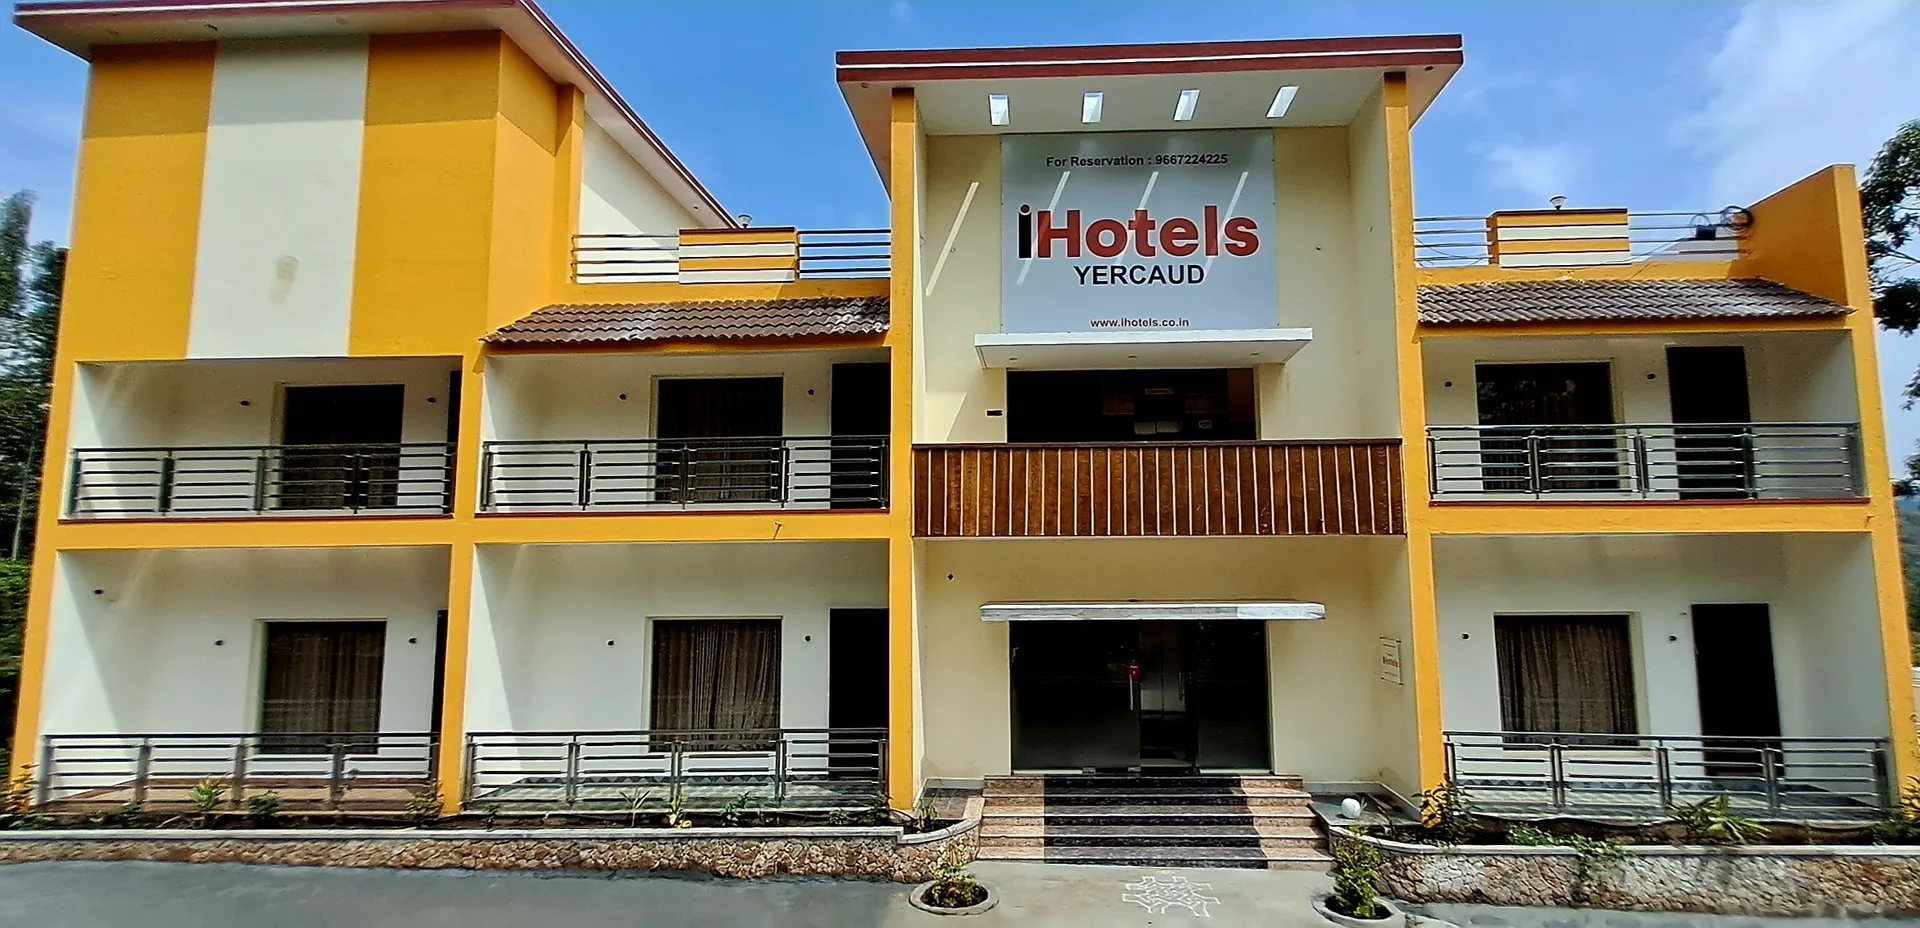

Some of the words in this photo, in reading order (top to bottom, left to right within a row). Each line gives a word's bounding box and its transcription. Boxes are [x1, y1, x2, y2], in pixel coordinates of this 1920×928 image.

[1046, 156, 1067, 167] For
[1070, 155, 1144, 167] Reservation
[1155, 153, 1228, 166] 9667224225
[1018, 204, 1260, 259] iHotels
[1073, 264, 1205, 285] YERCAUD
[1090, 317, 1190, 328] www.ihotels.co.in
